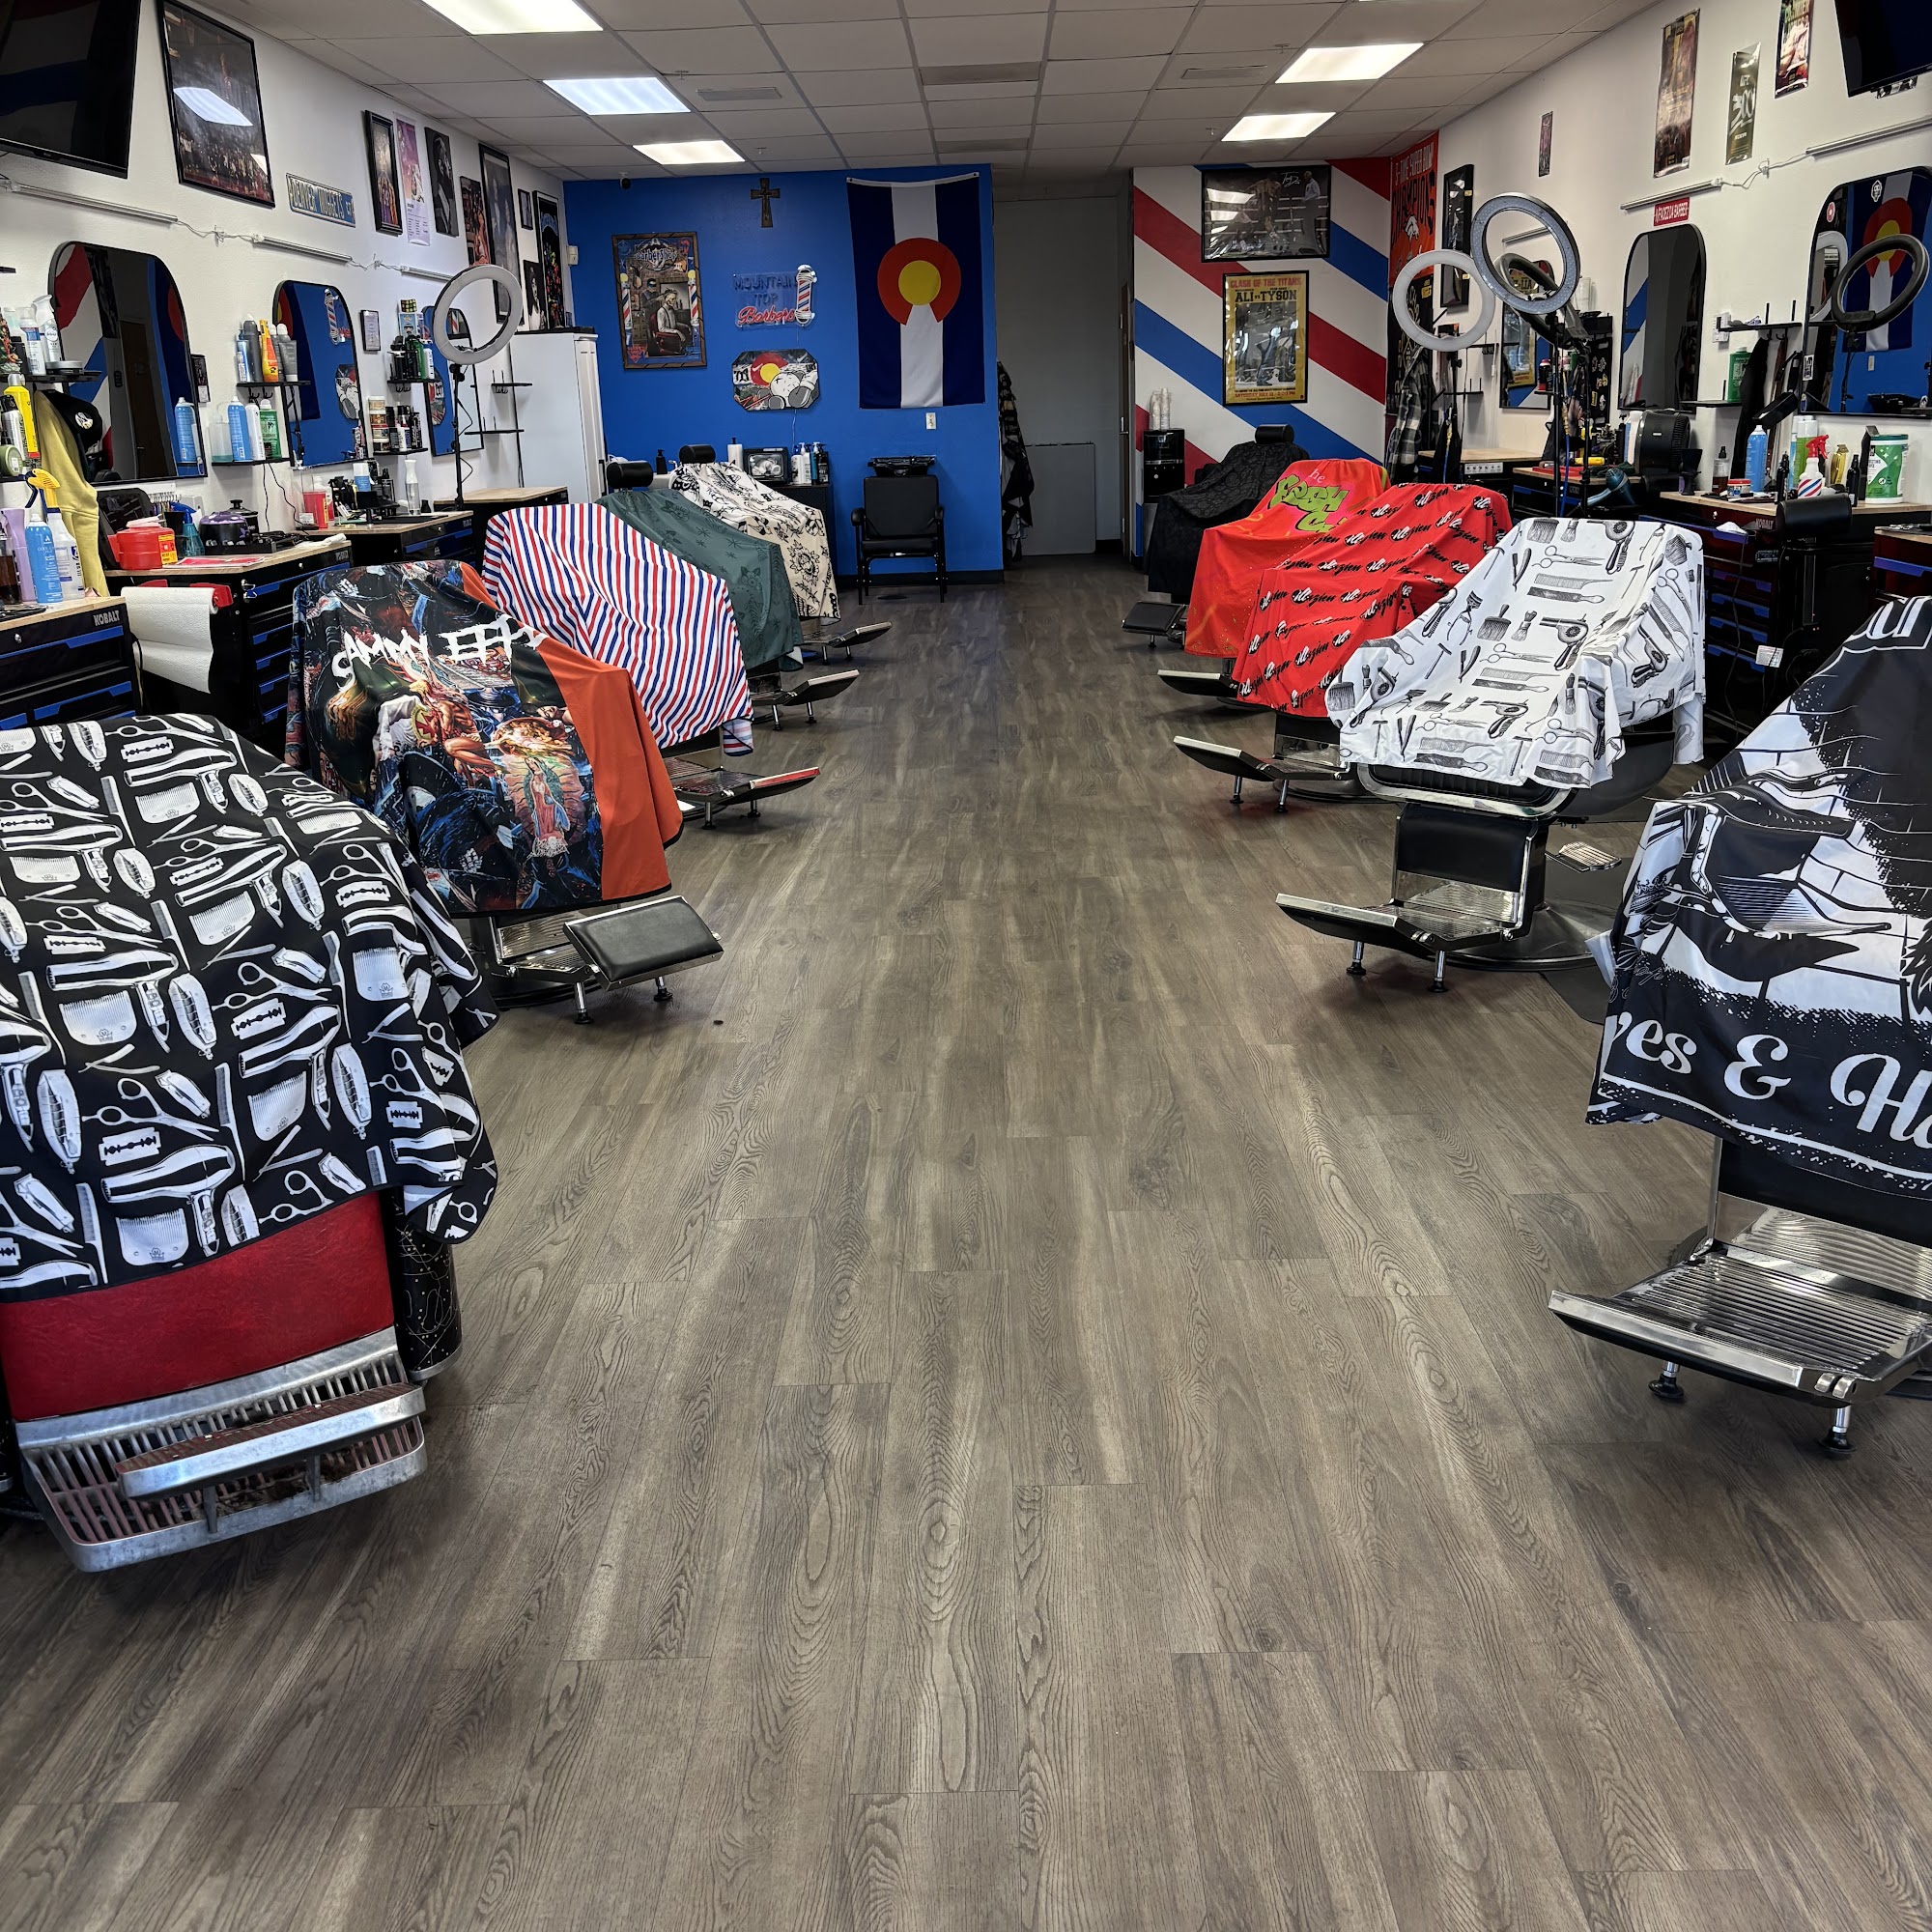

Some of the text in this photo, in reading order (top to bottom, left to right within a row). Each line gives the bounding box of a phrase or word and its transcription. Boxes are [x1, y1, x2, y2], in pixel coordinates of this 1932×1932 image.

[291, 177, 318, 212] DENVER
[317, 186, 345, 219] NUGGETS
[734, 274, 797, 291] MOUNTAIN
[1230, 276, 1302, 289] CLASH OF THE TITANS
[754, 292, 779, 306] TOP
[1236, 292, 1255, 302] ALI
[1261, 290, 1297, 301] TYSON
[737, 304, 797, 326] Barbers
[1308, 469, 1326, 484] he
[93, 610, 121, 627] KOBALT
[1723, 1033, 1792, 1100] &
